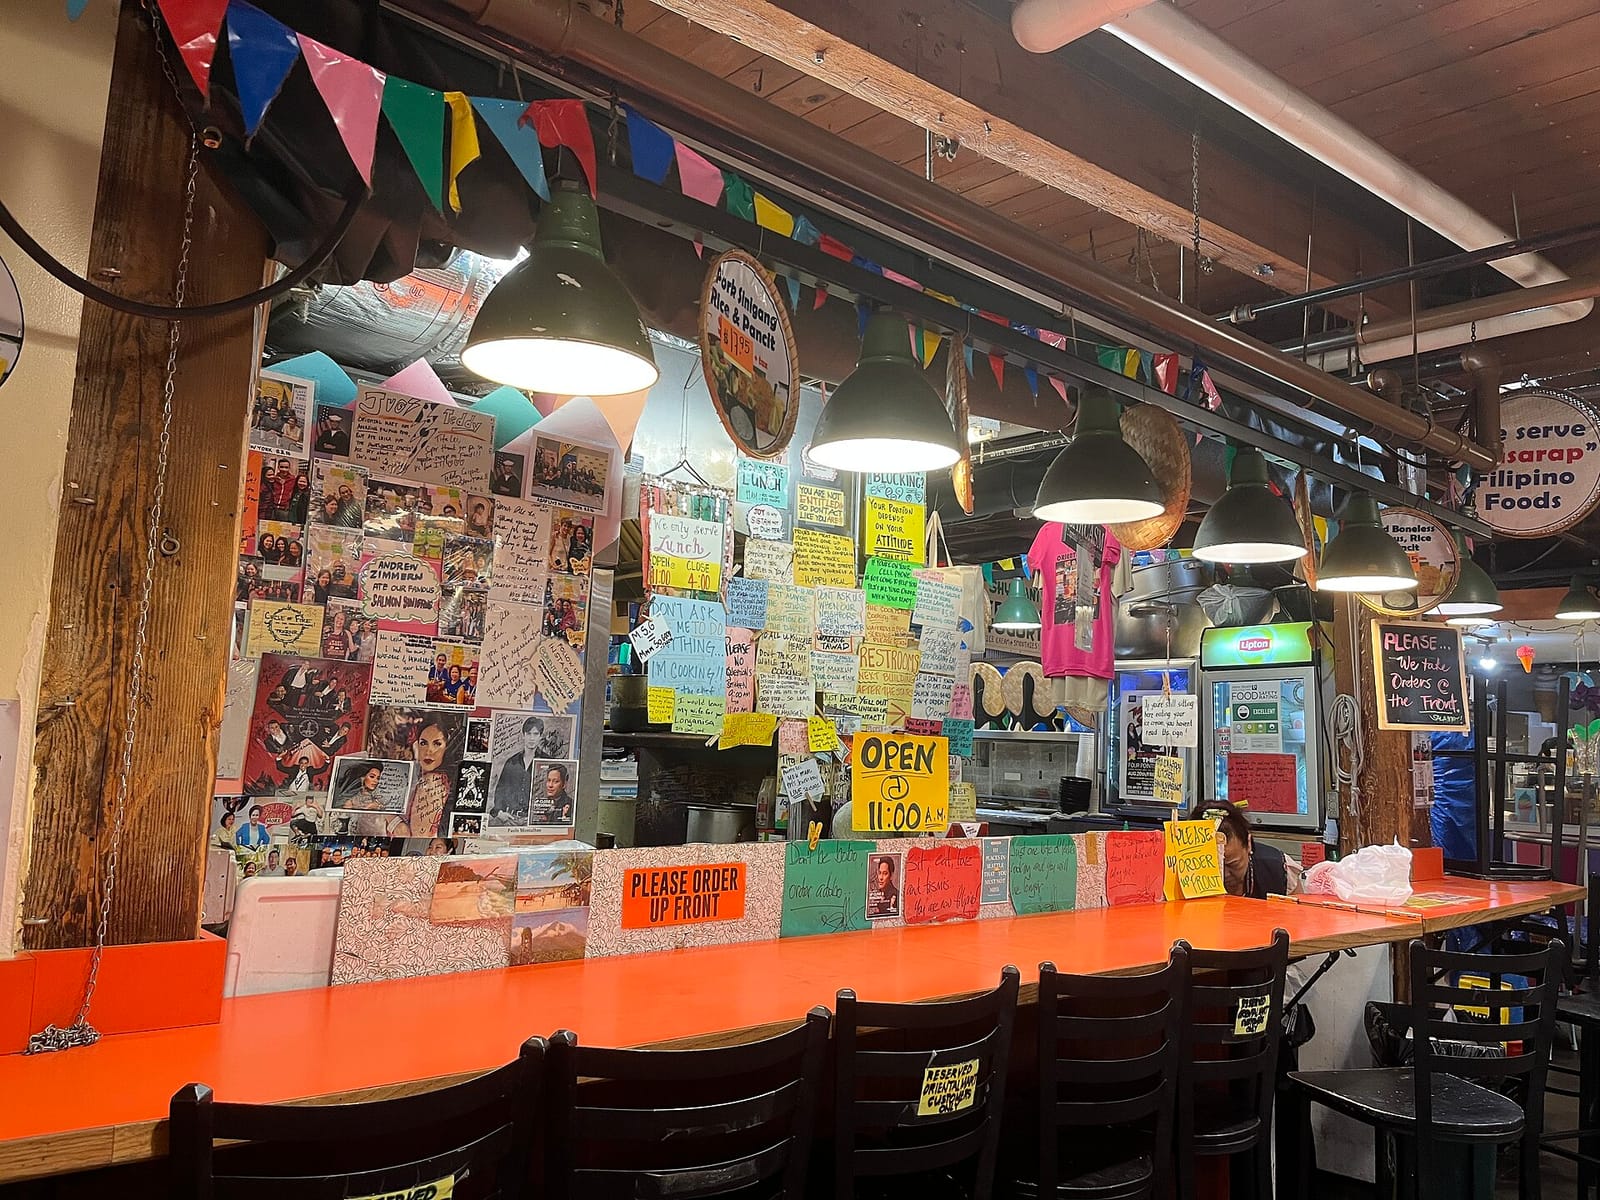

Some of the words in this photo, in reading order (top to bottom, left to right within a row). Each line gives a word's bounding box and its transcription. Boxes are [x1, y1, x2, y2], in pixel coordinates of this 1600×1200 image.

[738, 288, 778, 331] Sinigang
[710, 287, 730, 318] Rice
[732, 307, 740, 327] &
[742, 314, 776, 351] Pancit
[443, 408, 482, 433] Teddy
[1500, 429, 1508, 441] e
[1516, 424, 1585, 440] serve
[1503, 442, 1598, 464] sarap”
[742, 472, 781, 491] LUNCH
[873, 473, 925, 489] BLOCKING?
[1478, 469, 1575, 489] Filipino
[799, 486, 813, 495] YOU
[827, 491, 842, 500] NOT
[1485, 492, 1561, 510] Foods
[754, 508, 766, 516] JOY
[799, 504, 808, 512] SO
[828, 507, 842, 517] ACT
[869, 498, 886, 511] YOUR
[889, 503, 914, 515] PORTION
[800, 512, 814, 520] LIKE
[815, 514, 827, 522] YOU
[878, 512, 904, 523] DEPENDS
[653, 517, 668, 530] We
[671, 521, 689, 539] only
[694, 523, 719, 536] serve
[875, 523, 884, 531] ON
[887, 524, 905, 534] YOUR
[1393, 525, 1435, 533] Boneless
[653, 535, 706, 557] Lunch
[876, 534, 914, 550] ATTITUDE
[1410, 534, 1432, 542] Rice
[378, 561, 419, 571] ANDREW
[686, 560, 710, 573] CLOSE
[370, 570, 424, 580] ZIMMERN
[688, 573, 711, 591] 4:00
[372, 583, 388, 591] ATE
[651, 601, 682, 617] DON'T
[689, 604, 718, 622] ASK
[676, 621, 690, 633] ME
[691, 621, 703, 634] TO
[709, 622, 723, 635] DO
[725, 636, 751, 656] PLEASE
[821, 643, 850, 651] TAWAD
[1241, 638, 1268, 651] Lipton
[734, 656, 744, 666] NO
[860, 647, 920, 676] RESTROOMS
[1392, 655, 1420, 671] We
[1421, 658, 1451, 672] take
[651, 661, 667, 679] I'M
[858, 671, 879, 680] NEXT
[695, 686, 715, 695] chef
[857, 685, 881, 695] AFTER
[883, 686, 895, 695] THE
[1390, 672, 1432, 690] Orders
[1437, 678, 1450, 695] @
[687, 698, 705, 706] would
[1232, 692, 1258, 700] FOOD
[1387, 693, 1414, 708] the
[861, 737, 937, 774] OPEN
[881, 775, 910, 801] @
[868, 801, 921, 830] 11:00
[1166, 855, 1177, 873] UP
[1179, 854, 1216, 874] ORDER
[631, 870, 689, 898] PLEASE
[692, 868, 738, 893] ORDER
[789, 875, 812, 899] order
[1191, 873, 1221, 894] FRONT
[650, 897, 669, 923] UP
[673, 893, 720, 921] FRONT
[926, 1063, 973, 1082] RESERVED
[923, 1079, 960, 1096] ORIENTAL
[939, 1100, 960, 1113] ONLY
